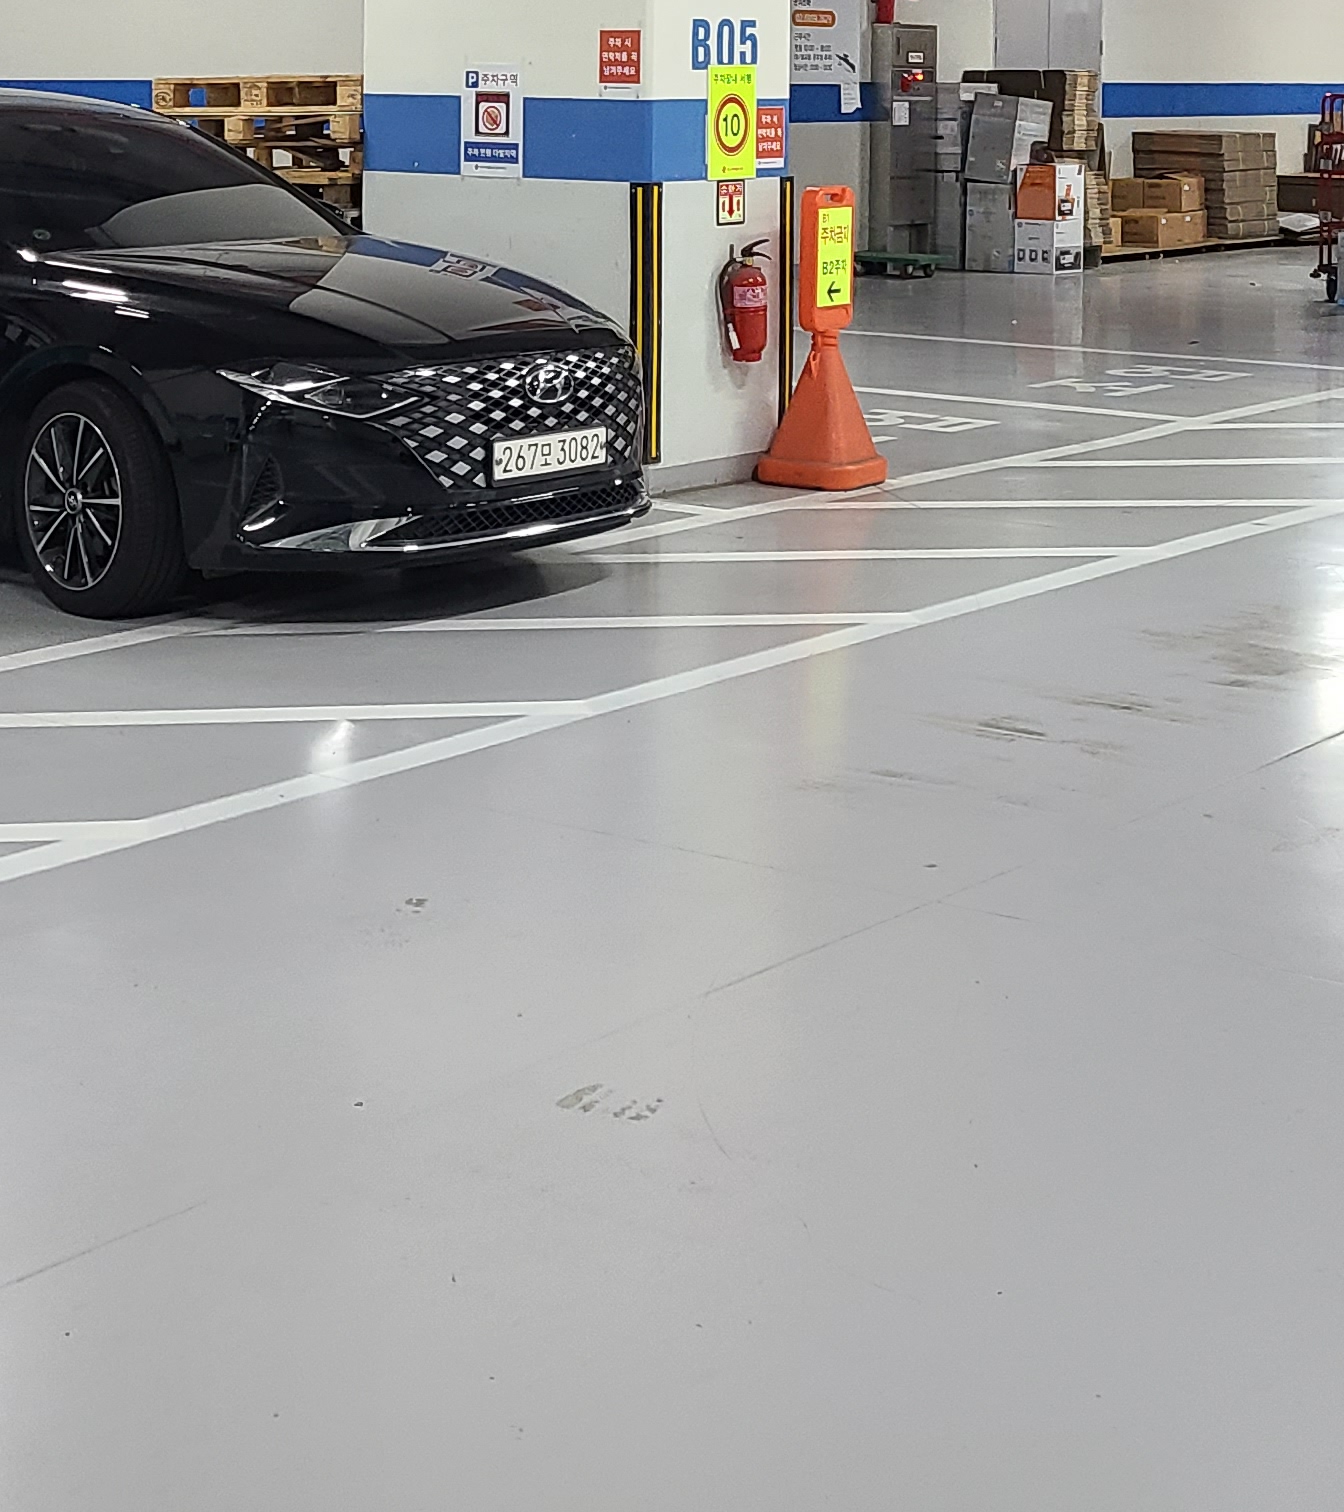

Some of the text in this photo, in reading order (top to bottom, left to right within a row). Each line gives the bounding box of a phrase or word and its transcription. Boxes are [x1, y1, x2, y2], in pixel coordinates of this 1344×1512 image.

[691, 18, 758, 70] B05
[481, 73, 518, 86] 주차구역
[740, 73, 752, 85] 서행
[723, 113, 741, 137] 10
[720, 184, 743, 194] 소화기
[821, 225, 849, 245] 주차금지
[822, 259, 847, 276] B2주차
[502, 433, 600, 474] 267모 3082
